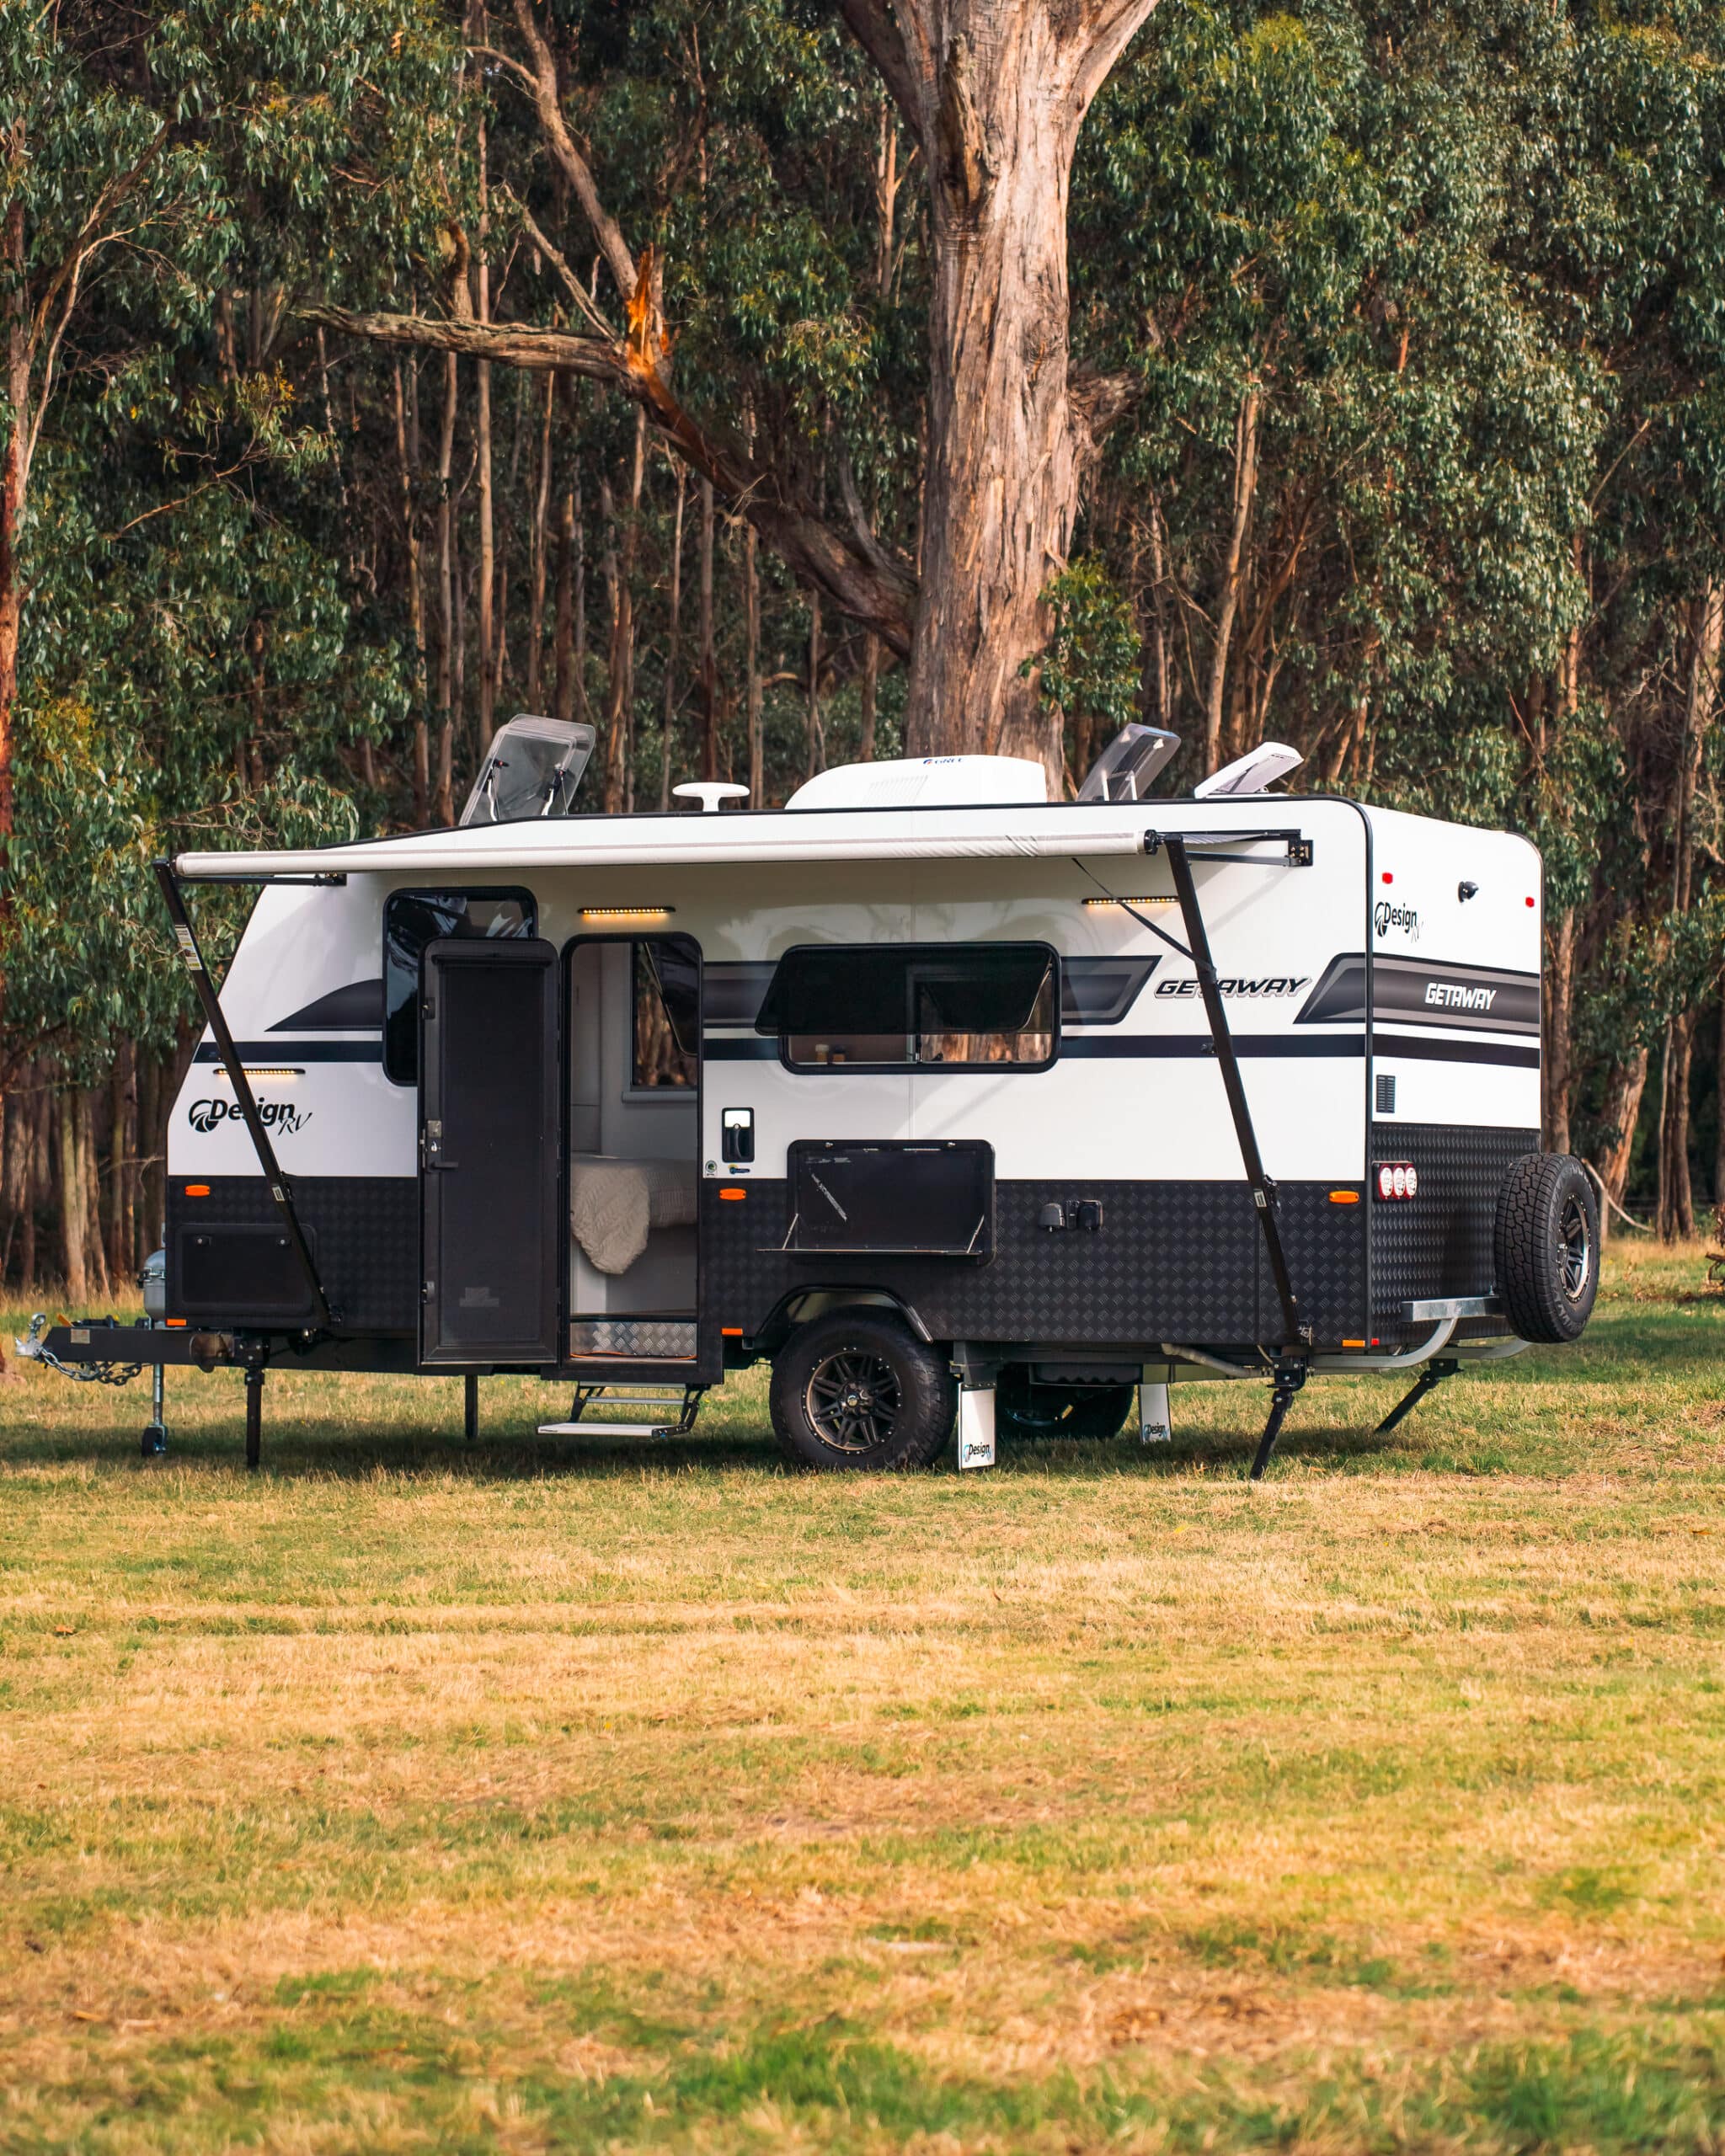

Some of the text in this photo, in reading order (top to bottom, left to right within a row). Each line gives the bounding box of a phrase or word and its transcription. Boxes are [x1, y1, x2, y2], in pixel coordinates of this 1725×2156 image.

[1384, 902, 1418, 934] Design
[1155, 978, 1311, 999] GEAWAY
[1424, 982, 1498, 1011] GETAWAY
[210, 1097, 313, 1136] Deign RV
[969, 1441, 991, 1458] Design
